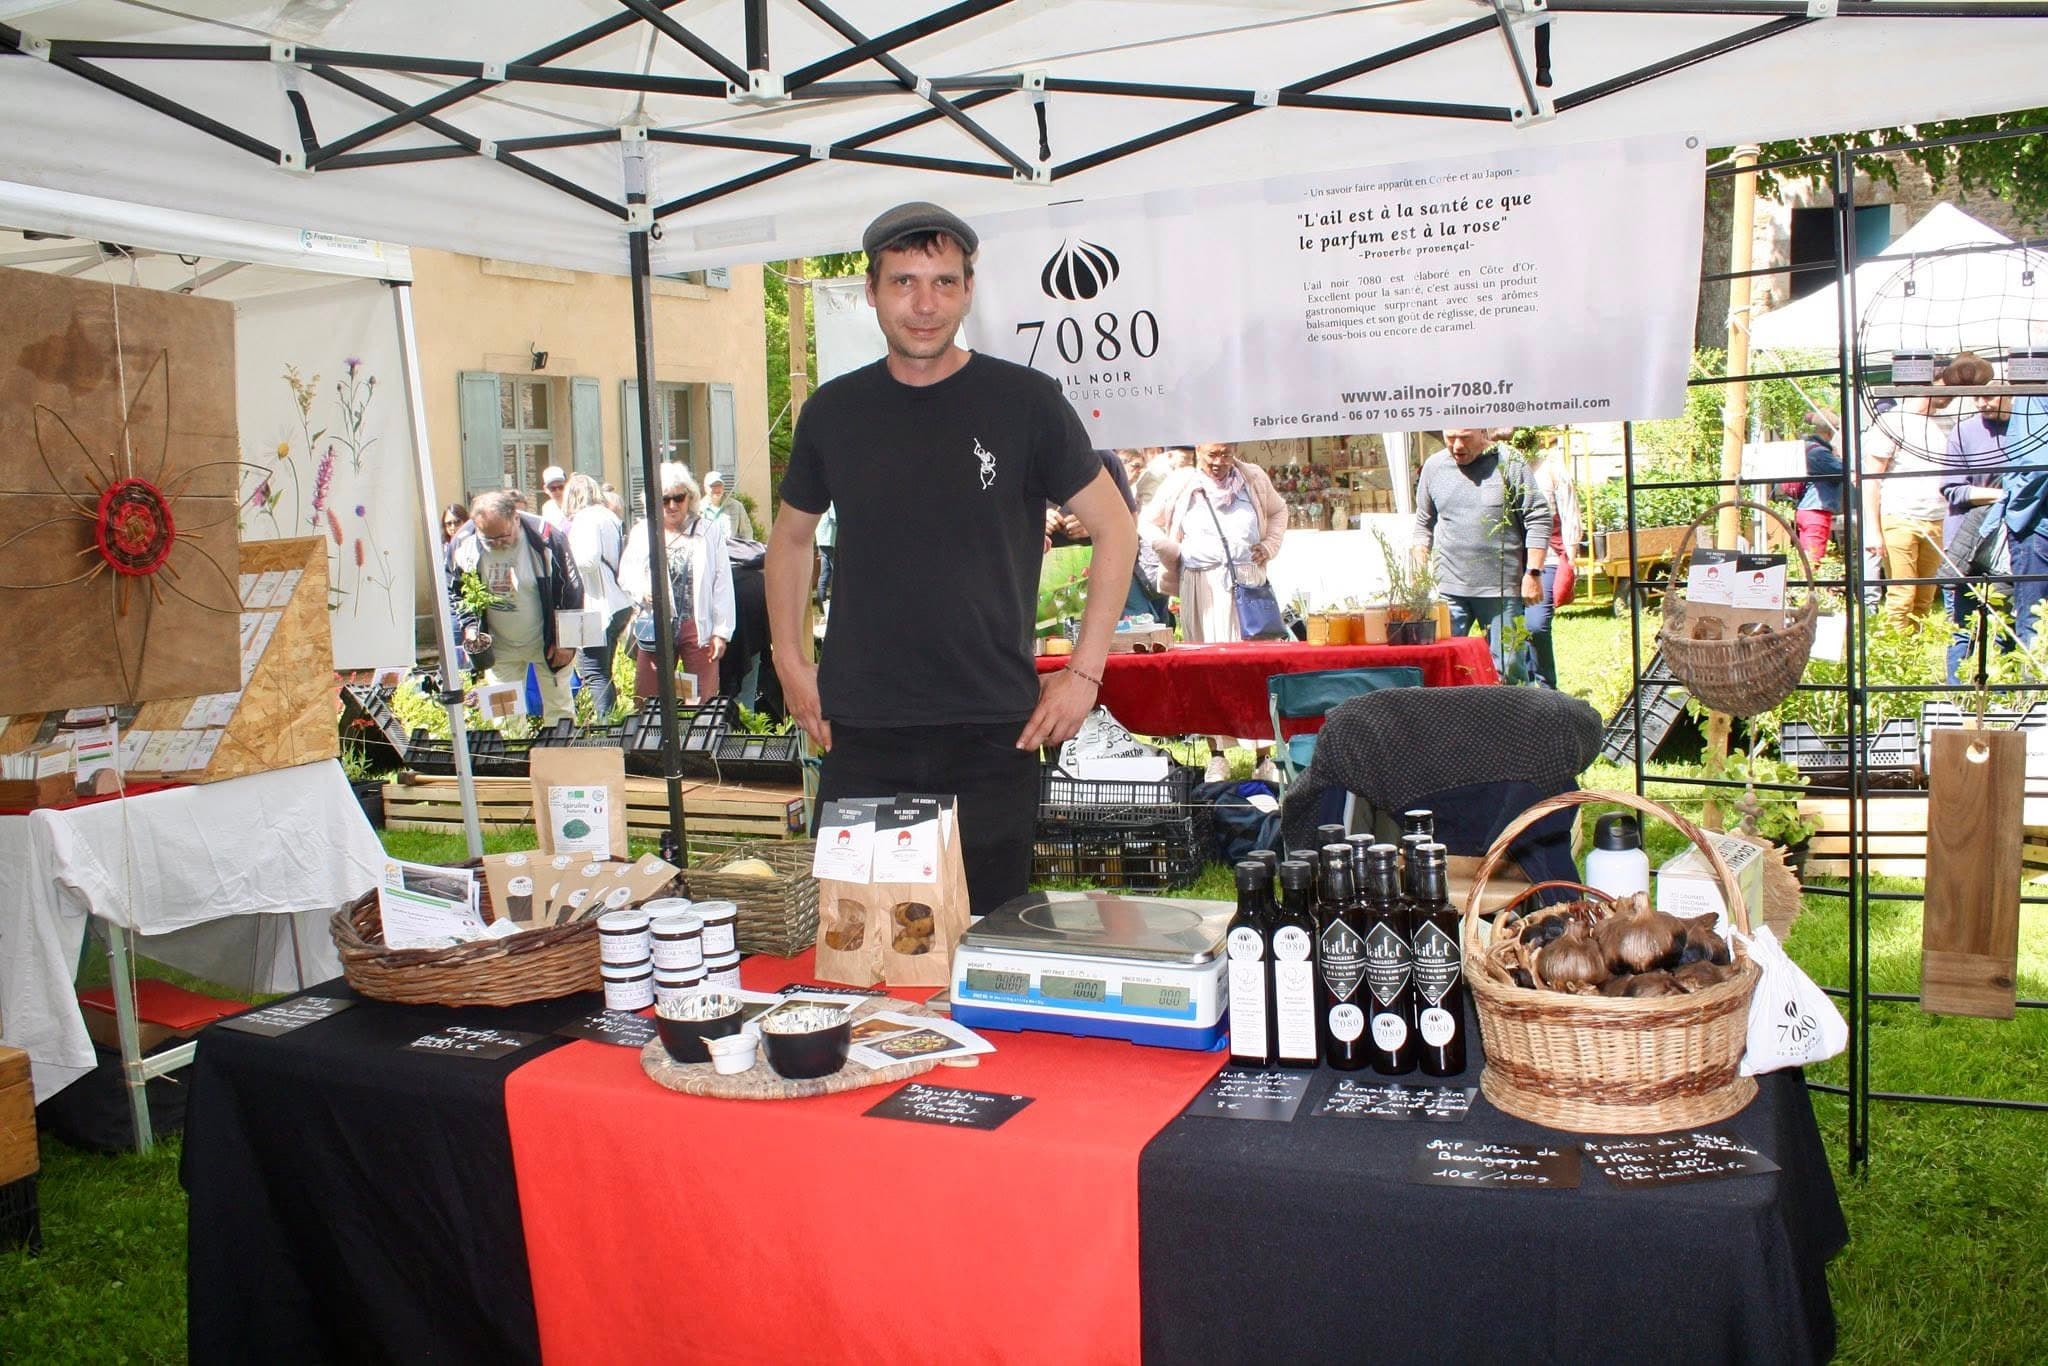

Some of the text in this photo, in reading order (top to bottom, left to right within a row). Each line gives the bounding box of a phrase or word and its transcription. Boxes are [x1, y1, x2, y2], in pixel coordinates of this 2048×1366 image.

[1310, 188, 1324, 198] Un
[1326, 184, 1353, 197] savoir
[1354, 182, 1376, 194] faire
[1415, 178, 1427, 187] en
[1429, 172, 1458, 186] Corée
[1459, 172, 1469, 181] et
[1471, 171, 1484, 180] au
[1485, 166, 1513, 181] Japon
[1349, 206, 1374, 223] est
[1381, 204, 1390, 219] à
[1397, 203, 1413, 218] la
[1420, 194, 1469, 216] santé
[1475, 197, 1494, 210] ce
[1501, 191, 1532, 211] que
[1299, 235, 1313, 250] le
[1321, 229, 1384, 252] parfum
[1391, 226, 1417, 241] est
[1423, 223, 1433, 239] à
[1440, 221, 1456, 237] la
[1303, 280, 1322, 291] L'ail
[1330, 279, 1350, 289] noir
[1357, 275, 1382, 286] 7080
[1390, 274, 1405, 283] est
[1414, 269, 1450, 281] élaboré
[1458, 269, 1471, 277] en
[1479, 265, 1504, 275] Côte
[1307, 291, 1351, 303] Excellent
[1354, 289, 1378, 302] pour
[1381, 287, 1390, 297] la
[1427, 282, 1450, 293] c'est
[1453, 280, 1479, 291] aussi
[1482, 279, 1496, 289] un
[1500, 276, 1537, 289] produit
[1305, 289, 1539, 319] gastronomique surprenant avec ses arômes
[1306, 315, 1364, 330] balsamiques
[1366, 316, 1377, 325] et
[1378, 314, 1396, 323] son
[1397, 310, 1420, 323] goût
[1423, 310, 1435, 320] de
[1436, 307, 1478, 321] réglisse,
[1479, 305, 1492, 316] de
[1016, 309, 1160, 367] 7080
[1307, 321, 1476, 342] de sous-bois ou encore de caramel.
[1090, 371, 1132, 385] NOIR
[1069, 384, 1166, 401] OURGOGNE
[1341, 379, 1514, 404] www.ailnoir7080.fr
[1252, 395, 1611, 427] Fabrice Grand 06 07 10 65 75 ailnoir7080@hotmail.com
[1233, 941, 1258, 952] 7080
[1280, 940, 1305, 951] 7080
[1334, 1018, 1359, 1028] 7080
[1376, 1028, 1402, 1038] 7080
[1424, 1023, 1449, 1032] 7080
[1438, 1151, 1541, 1169] Bourgogne
[1536, 1147, 1560, 1157] de
